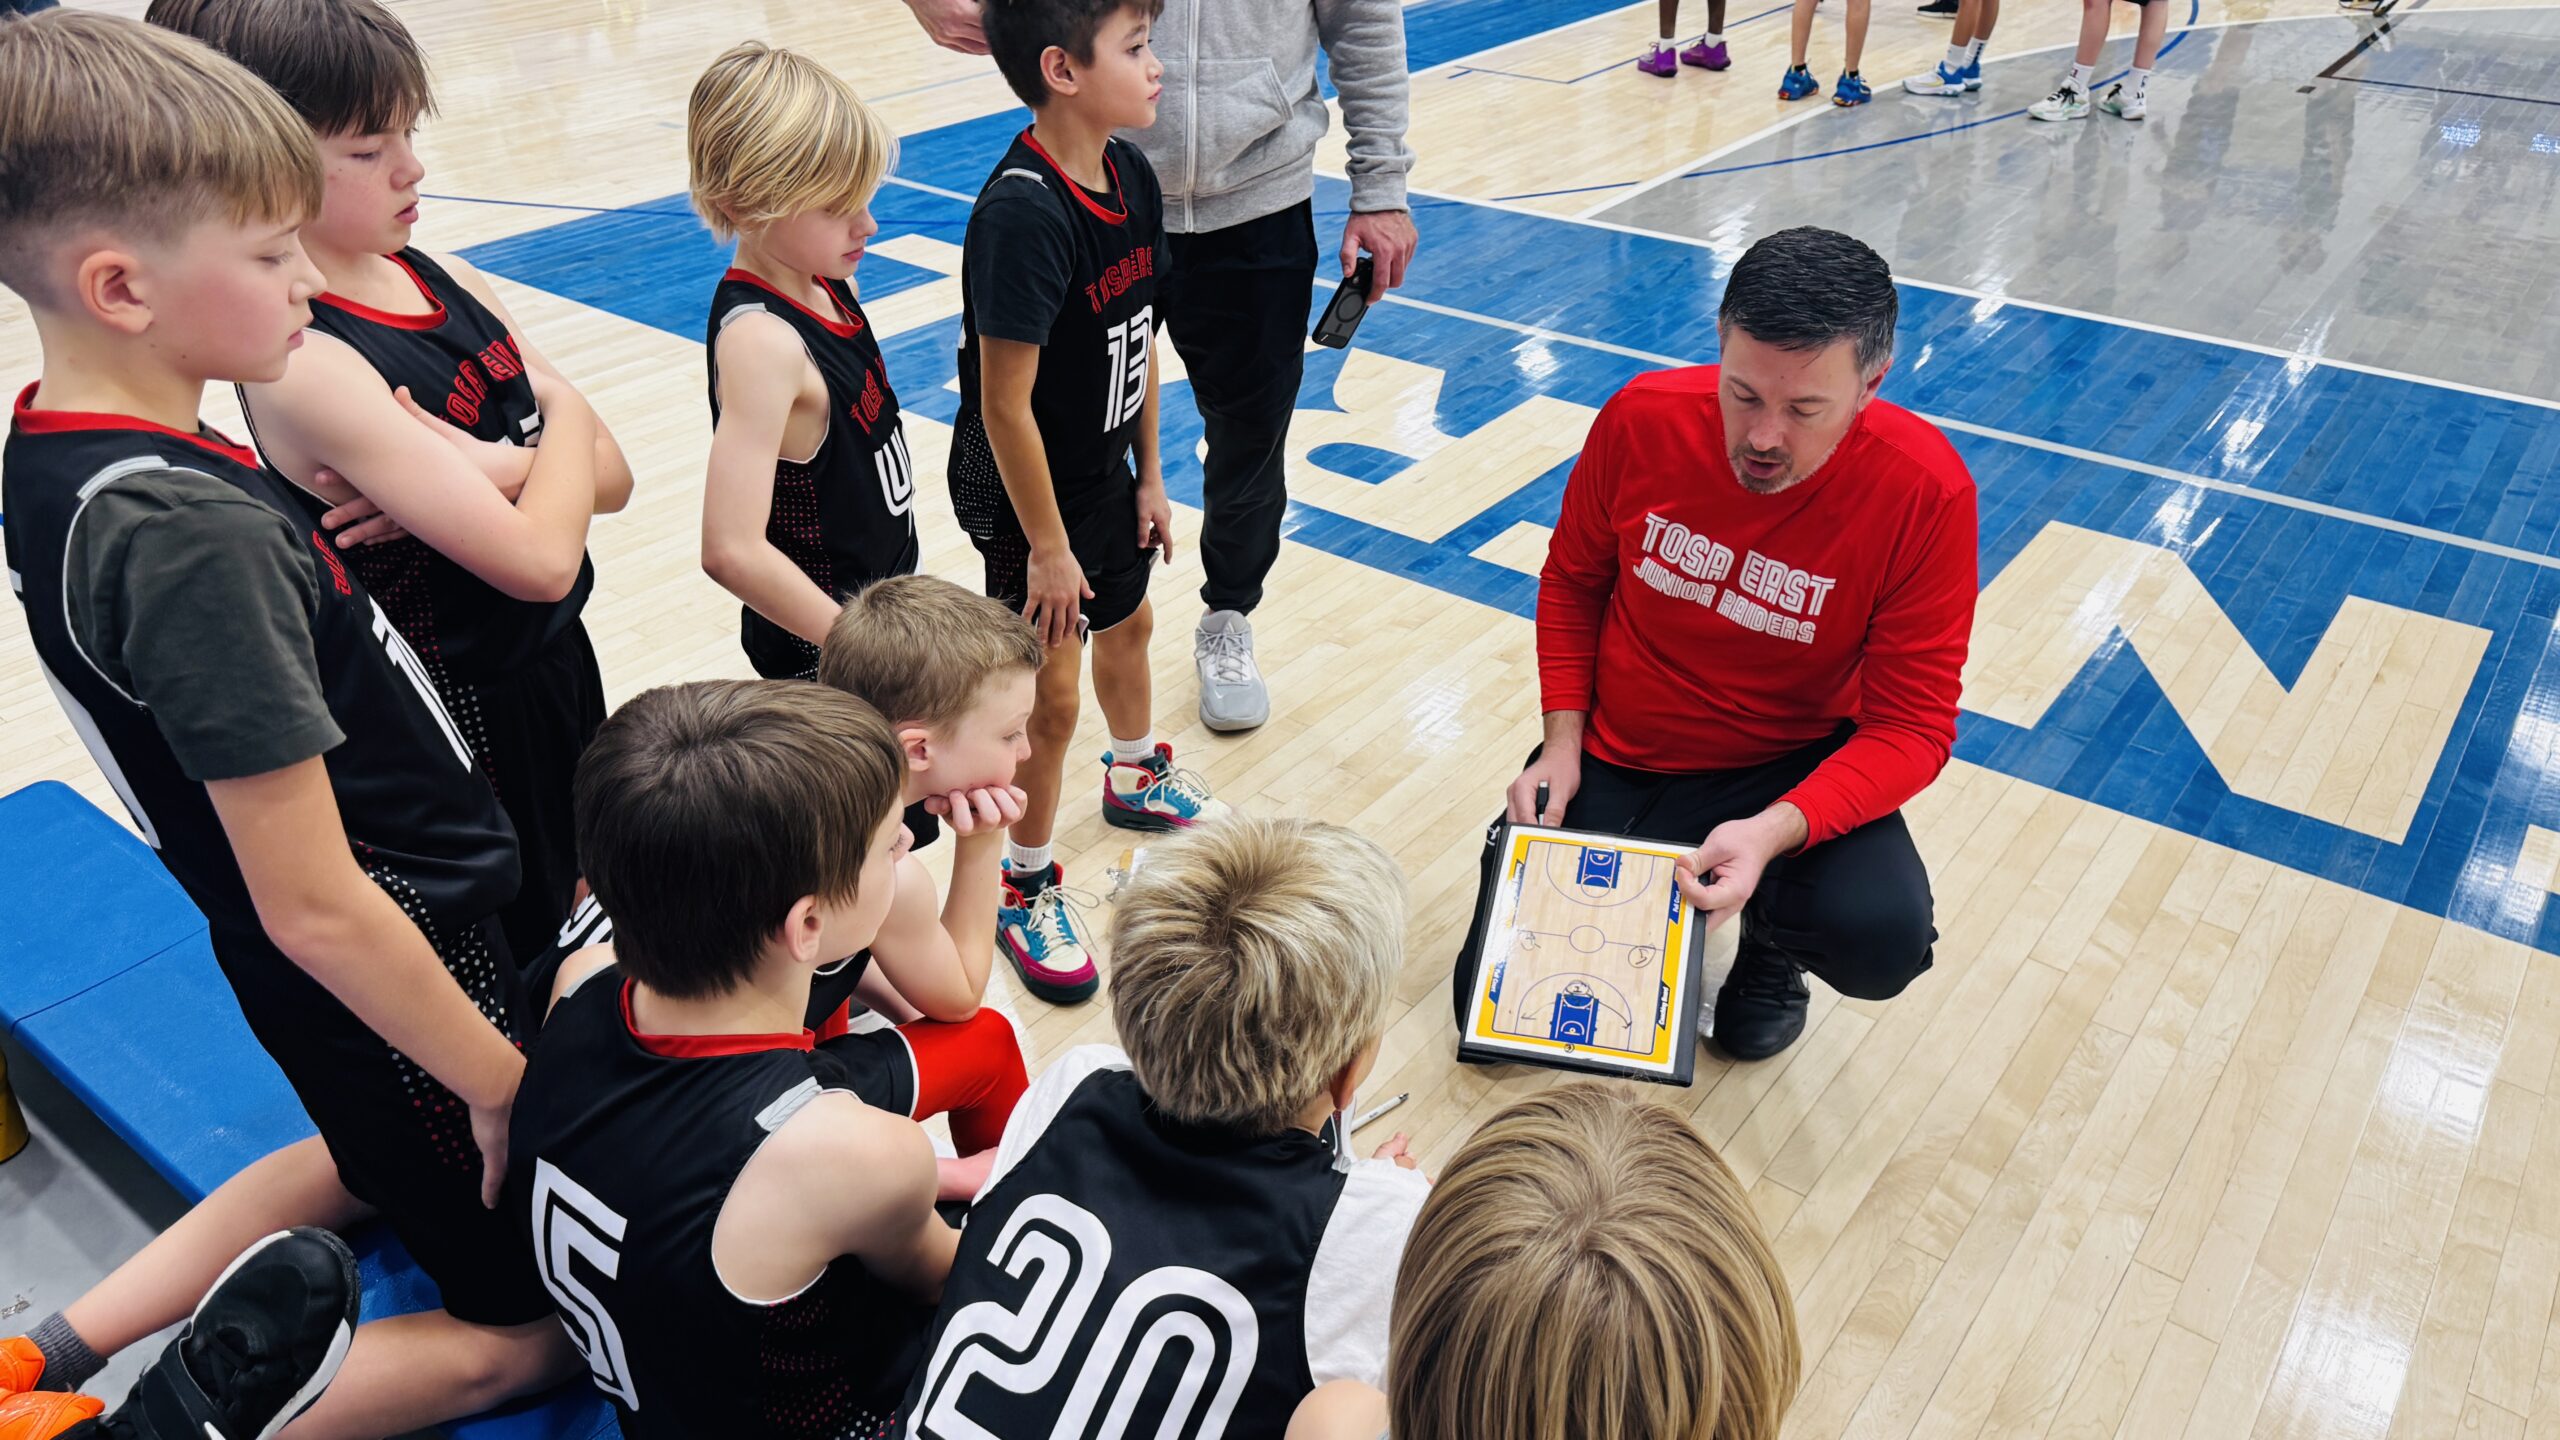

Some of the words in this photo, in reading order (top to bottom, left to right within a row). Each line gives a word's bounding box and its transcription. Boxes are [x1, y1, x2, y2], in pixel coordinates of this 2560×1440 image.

[1103, 305, 1153, 433] 13
[1632, 556, 1718, 608] JUNIOR
[1715, 588, 1817, 645] RAIDERS
[1641, 511, 1735, 582] TOSA
[1738, 549, 1837, 616] EAST
[531, 1157, 639, 1412] 5
[904, 1193, 1260, 1440] 20
